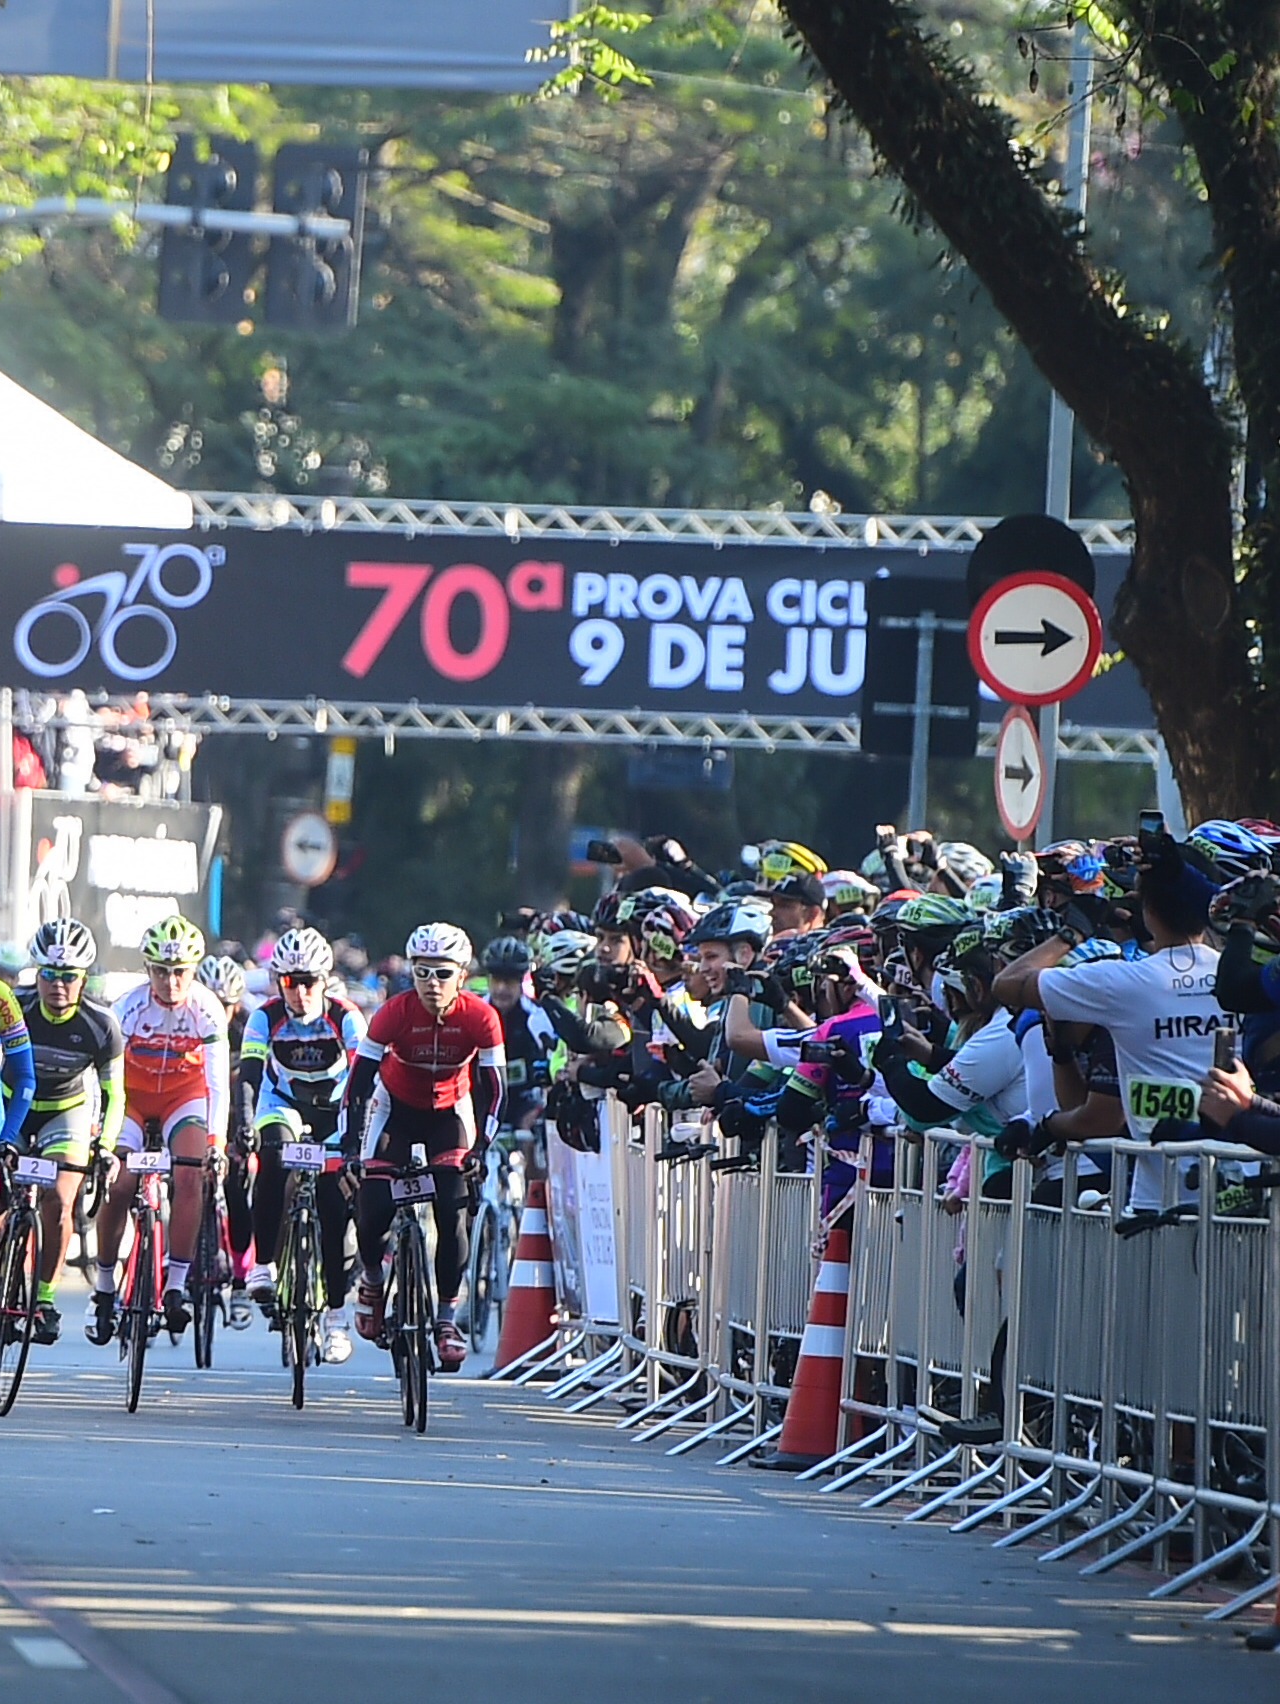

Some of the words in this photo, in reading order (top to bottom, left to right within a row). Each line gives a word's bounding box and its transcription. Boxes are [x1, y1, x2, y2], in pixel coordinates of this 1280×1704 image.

[572, 572, 753, 622] PROVA
[569, 618, 624, 686] 9
[648, 622, 746, 691] DE
[421, 939, 438, 953] 33
[57, 947, 66, 961] 2
[1154, 1013, 1246, 1040] HIRAT
[1131, 1081, 1195, 1119] 1549
[294, 1146, 313, 1161] 36
[31, 1161, 40, 1174] 2
[139, 1155, 157, 1168] 42
[403, 1180, 421, 1195] 33
